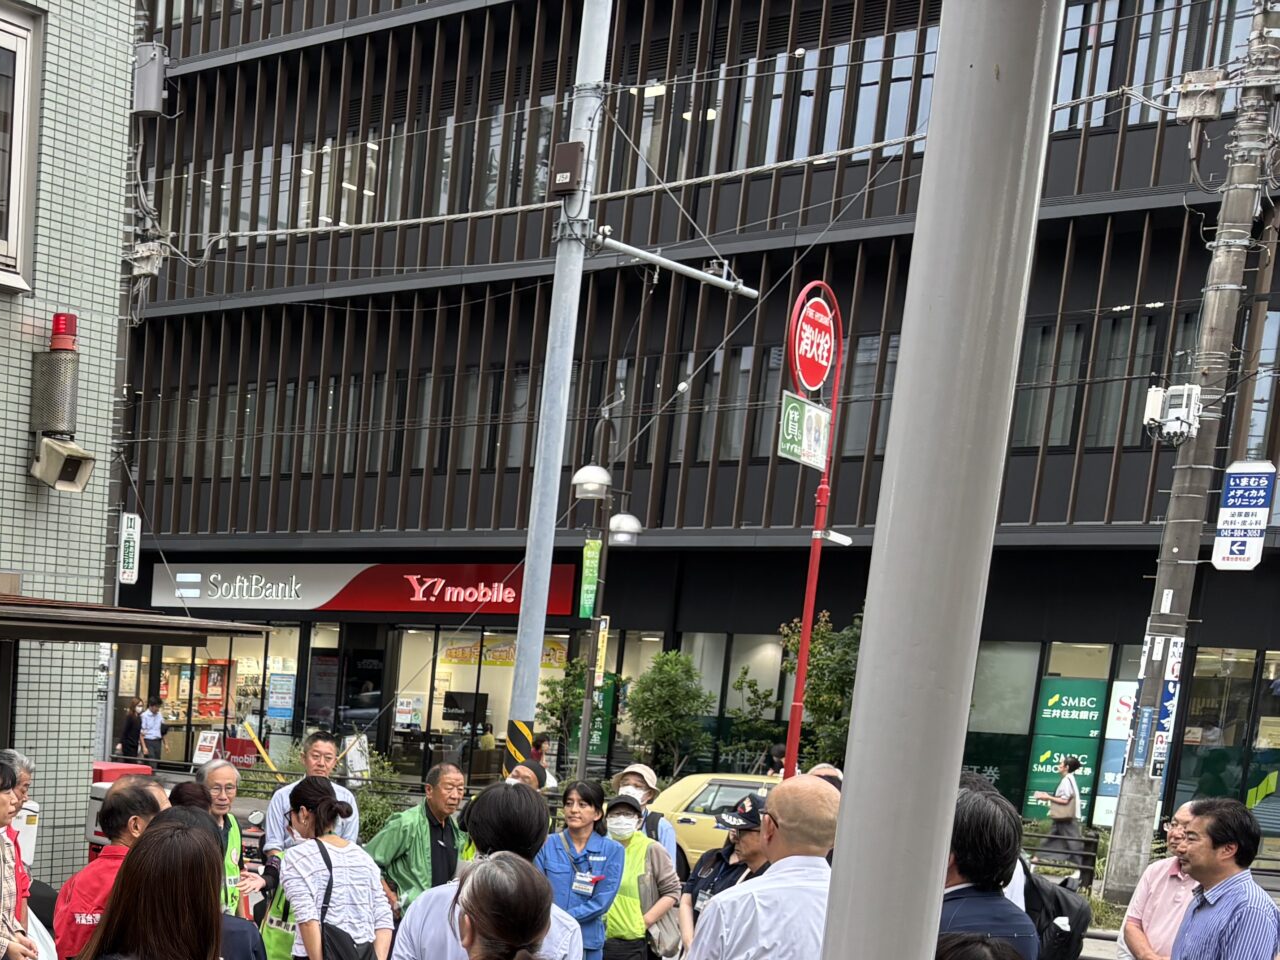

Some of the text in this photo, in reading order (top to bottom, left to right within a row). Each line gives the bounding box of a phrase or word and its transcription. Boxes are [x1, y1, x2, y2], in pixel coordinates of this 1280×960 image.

[799, 322, 831, 367] 消火栓
[1229, 477, 1269, 487] いまむら
[1228, 489, 1267, 498] メディカル
[1227, 498, 1265, 506] クリニック
[207, 573, 303, 600] SoftBank
[1061, 696, 1097, 708] SMBC
[1041, 709, 1099, 720] 三井住友銀行
